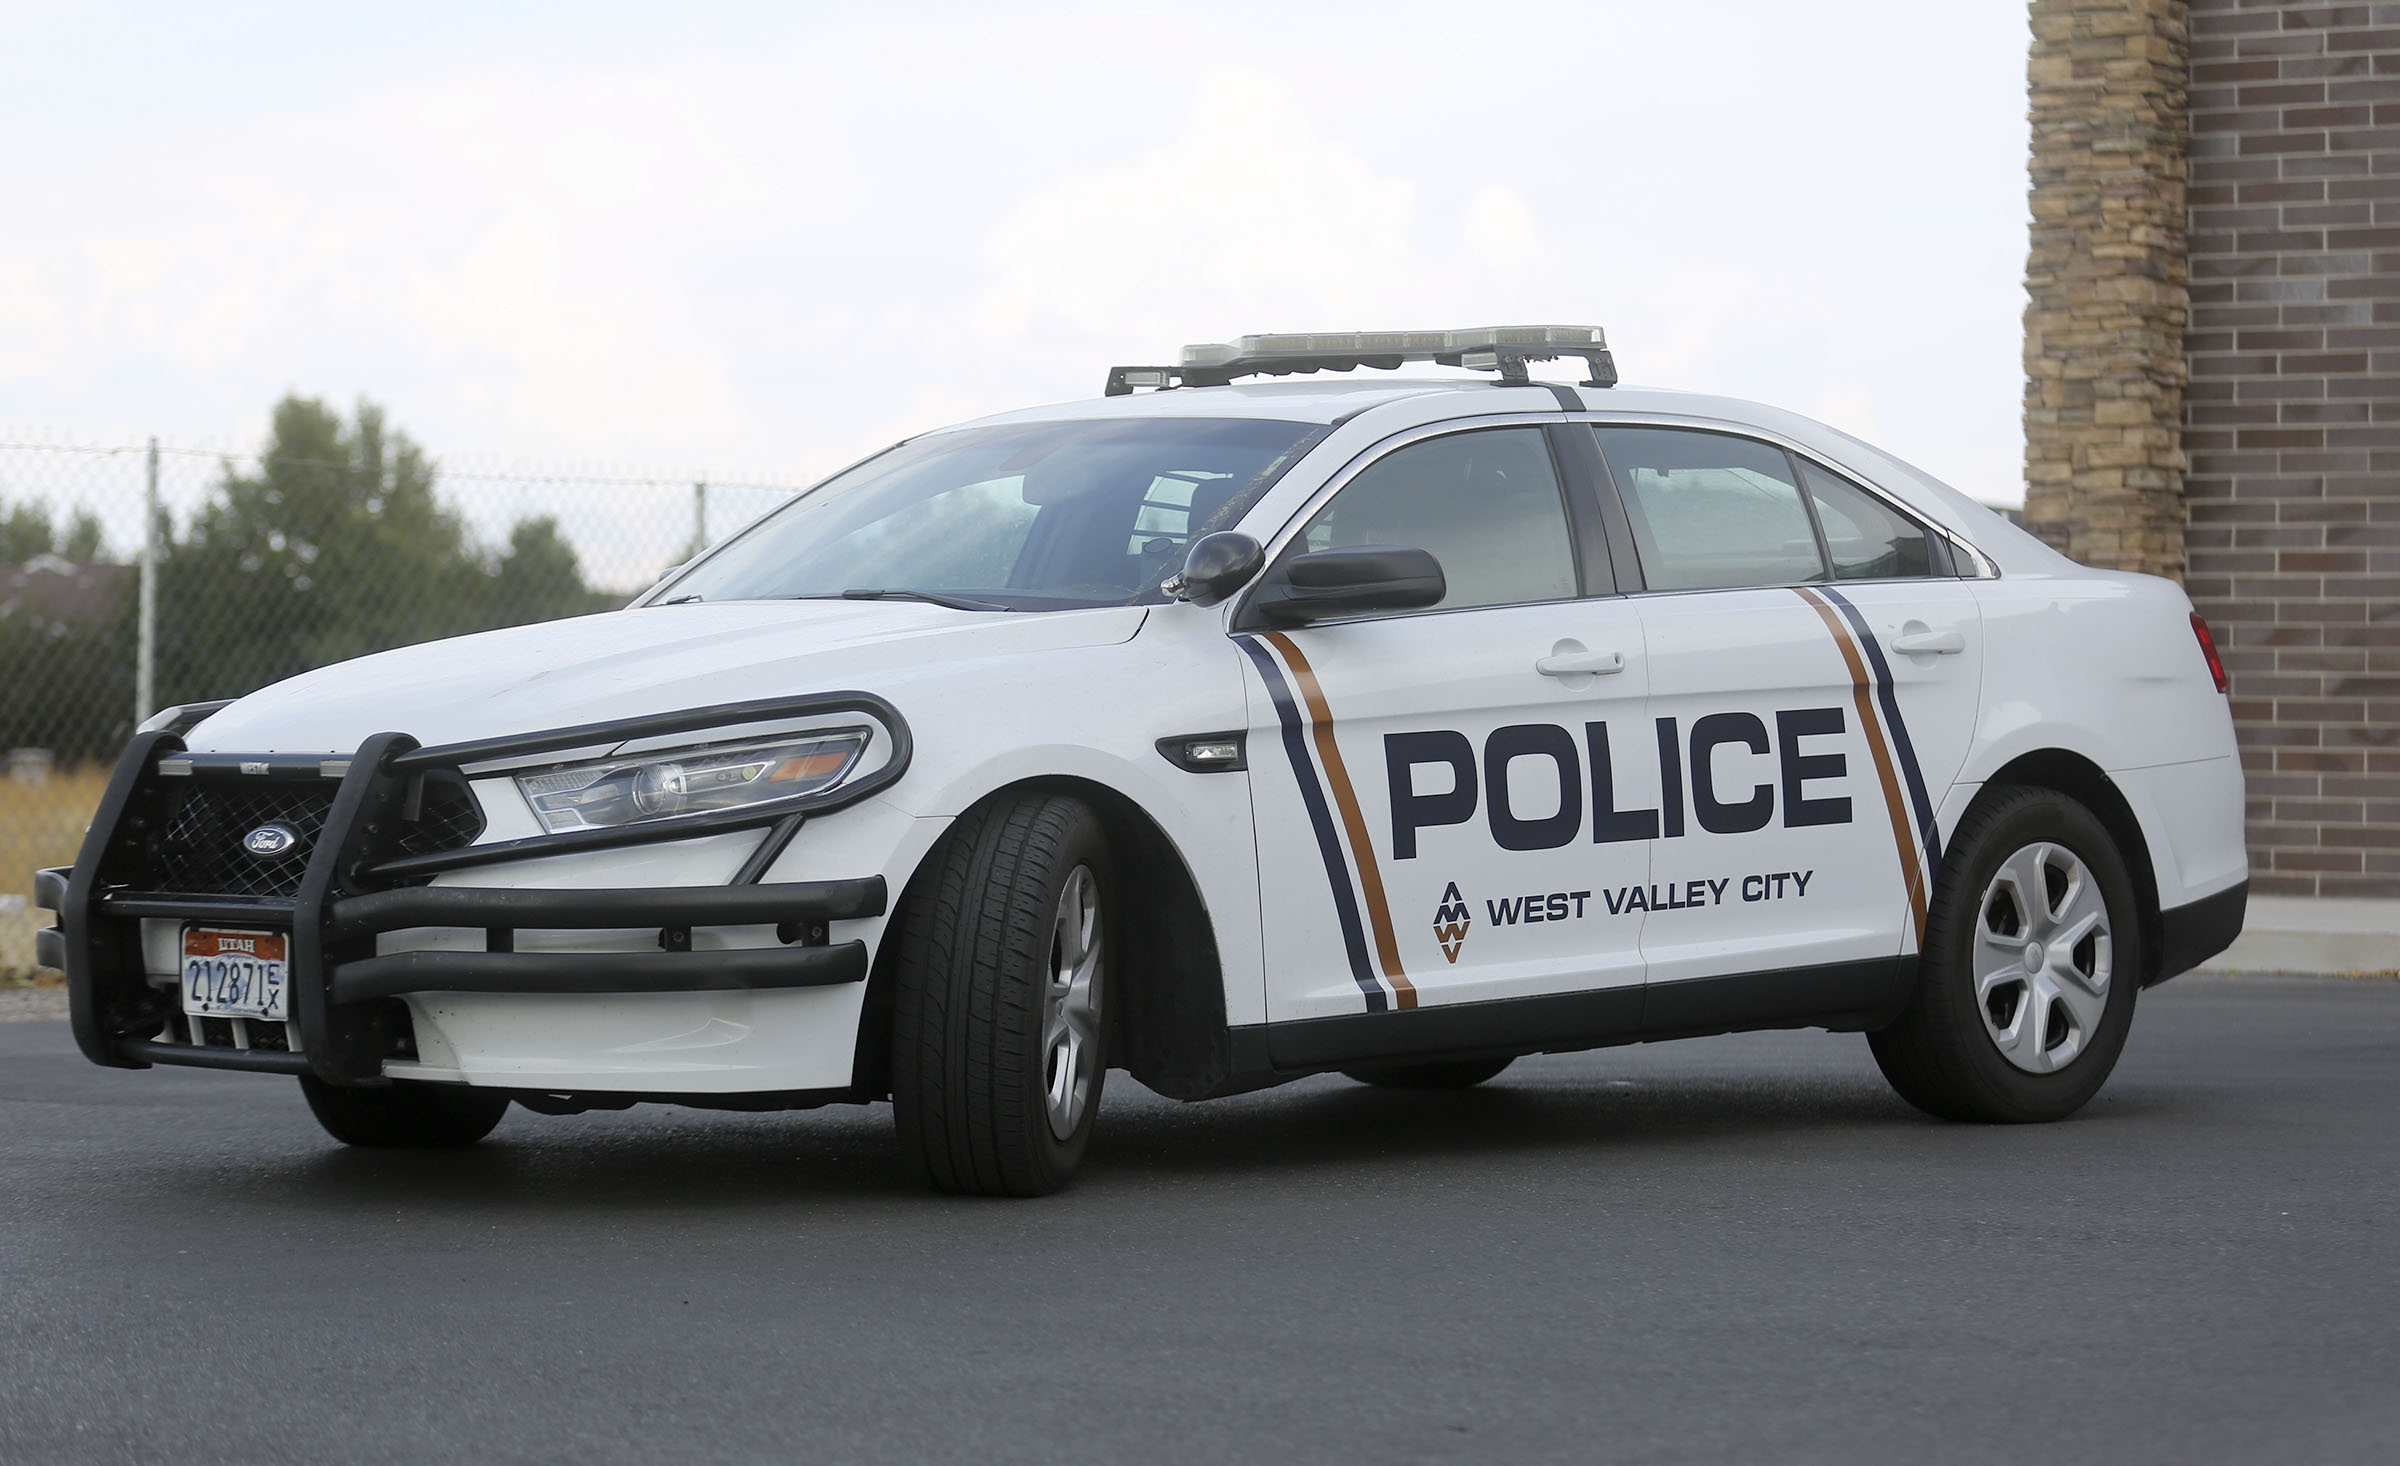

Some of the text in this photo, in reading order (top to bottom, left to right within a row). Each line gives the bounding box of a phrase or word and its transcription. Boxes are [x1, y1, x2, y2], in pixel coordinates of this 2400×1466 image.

[1383, 707, 1853, 860] POLICE
[251, 831, 280, 849] Ford
[1486, 871, 1814, 926] WEST VALLEY CITY
[218, 937, 255, 953] UTAH
[189, 960, 264, 1006] 212871
